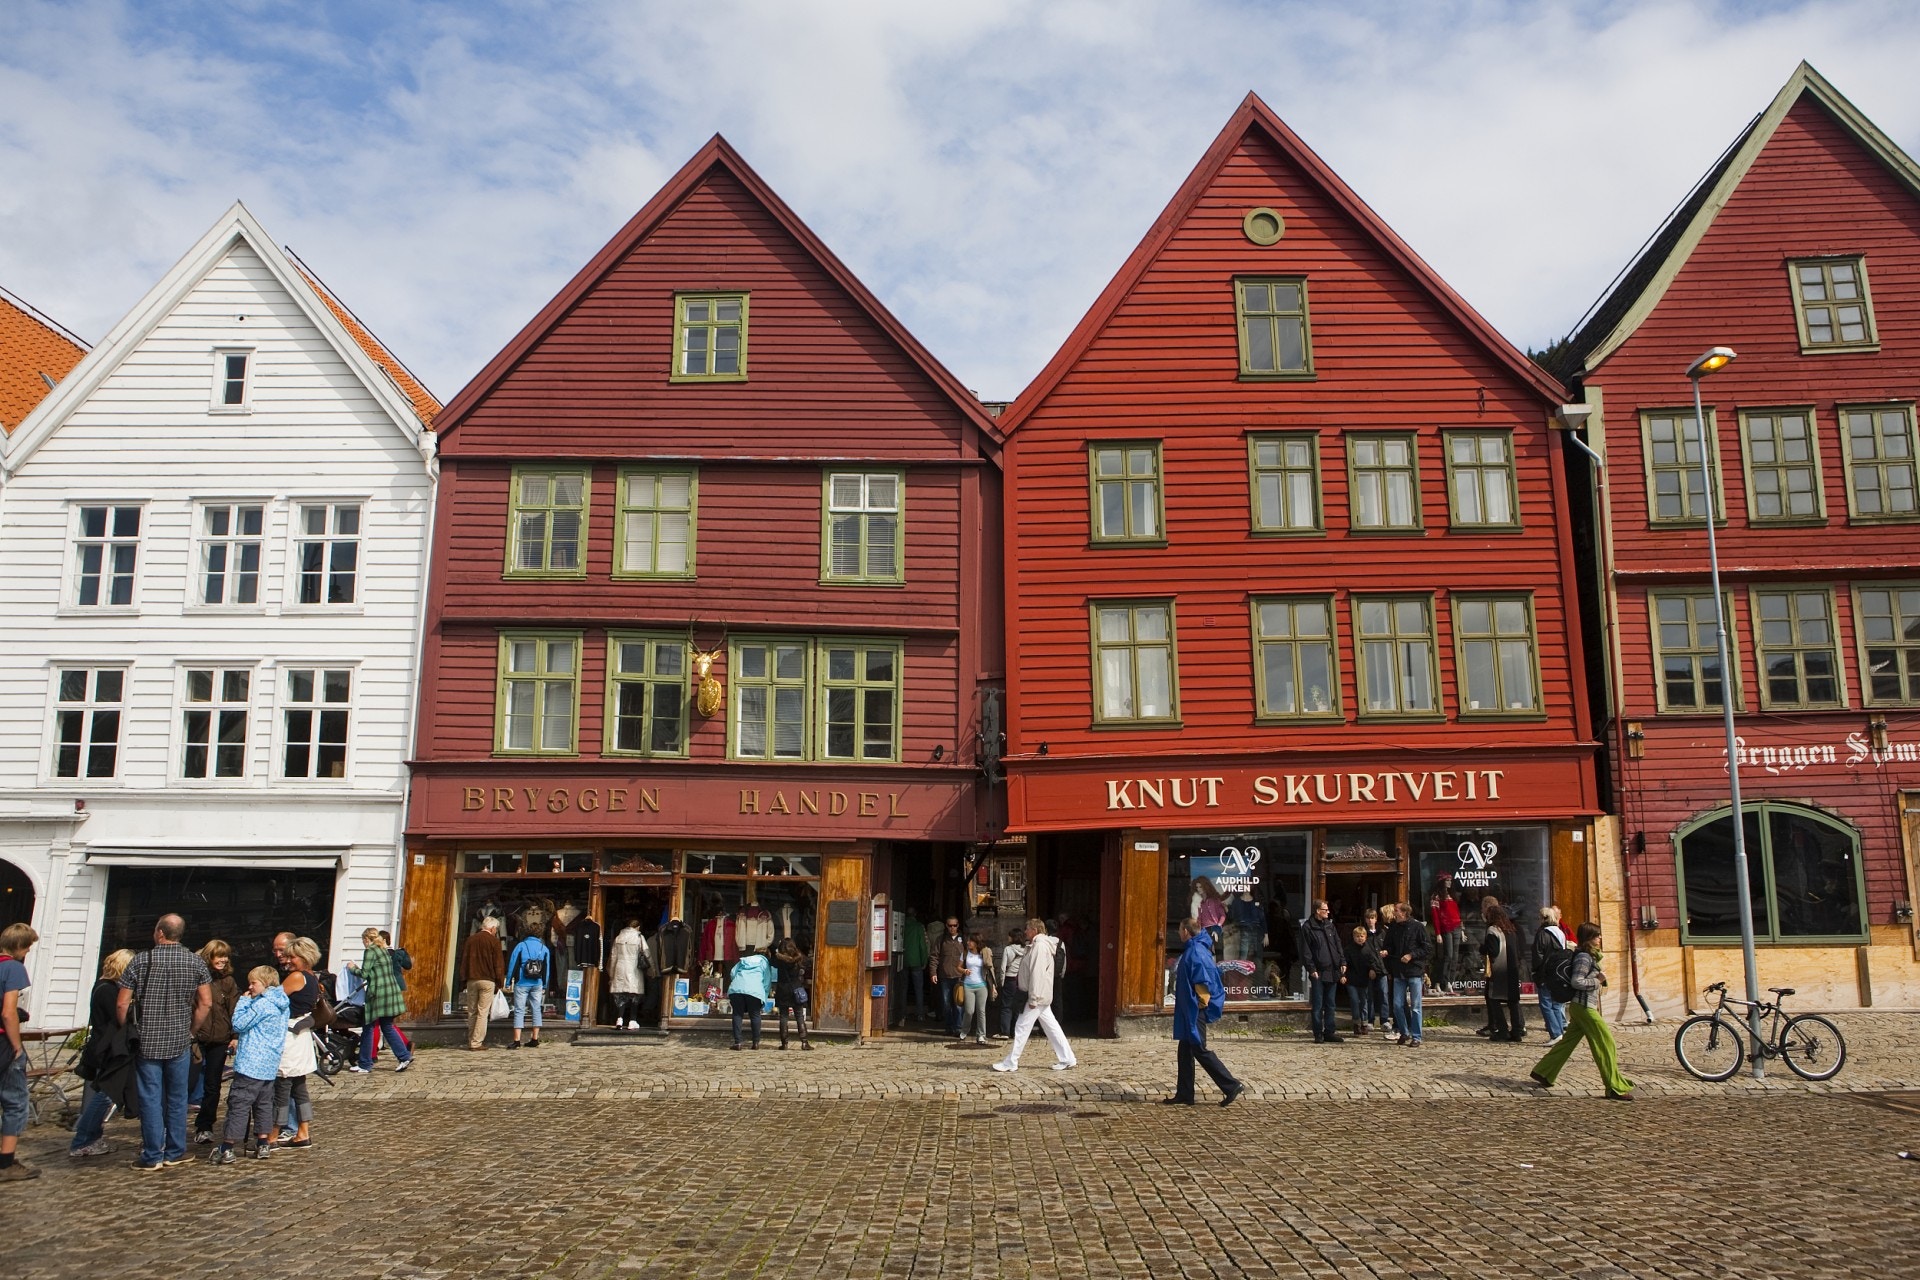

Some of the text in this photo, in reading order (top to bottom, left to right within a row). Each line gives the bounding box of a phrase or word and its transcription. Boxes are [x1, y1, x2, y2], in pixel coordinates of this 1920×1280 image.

[1723, 732, 1920, 776] Bryggen Sjøm
[1106, 770, 1505, 809] KNUT SKURTVEIT
[463, 787, 909, 818] BRYGGEN HANDEL
[1454, 871, 1498, 879] AUDHILD
[1215, 876, 1260, 884] AUDHILD
[1459, 879, 1489, 887] VIKEN
[1221, 884, 1251, 892] VIKEN
[1447, 980, 1487, 989] MEMORIE
[1223, 986, 1274, 994] RIES & GIFTS
